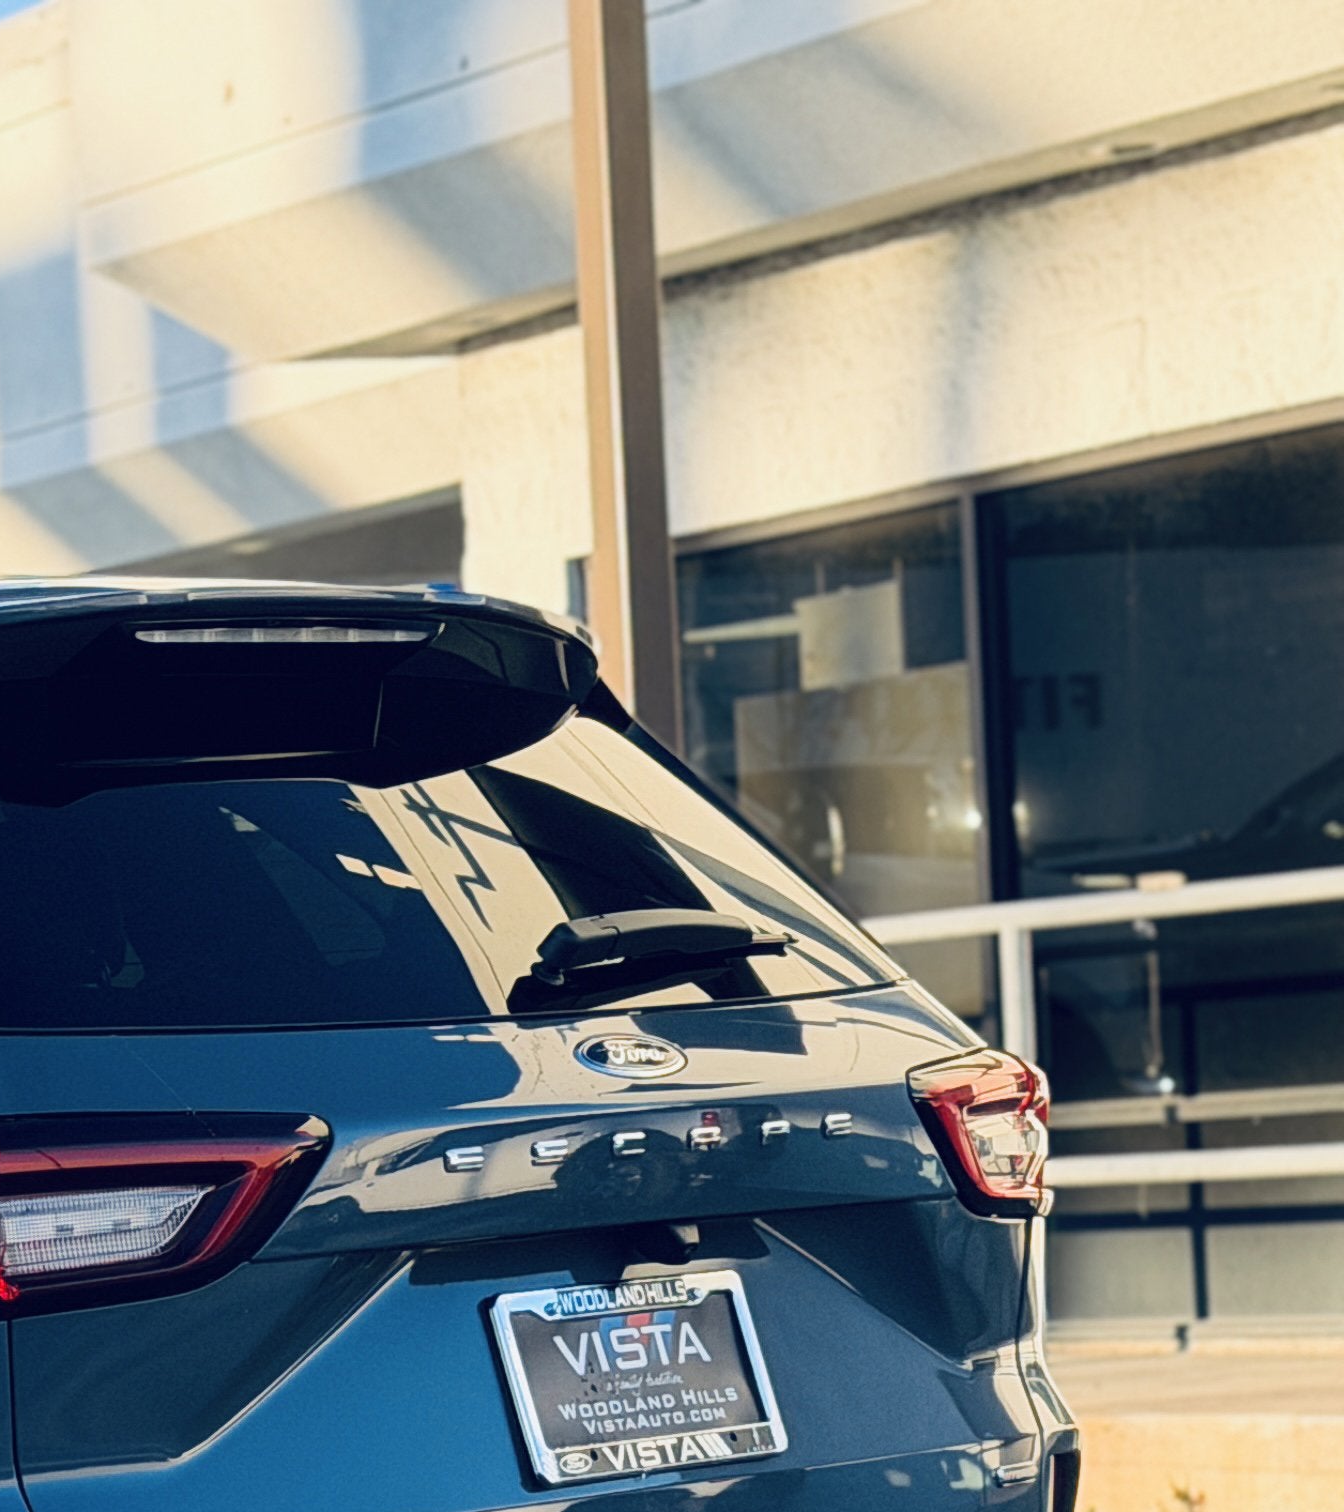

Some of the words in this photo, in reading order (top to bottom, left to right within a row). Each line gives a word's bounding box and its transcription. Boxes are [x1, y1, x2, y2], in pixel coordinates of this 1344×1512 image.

[601, 1039, 667, 1065] Ford
[443, 1111, 853, 1174] ESCAPE
[559, 1284, 647, 1315] WOODLAND
[647, 1279, 689, 1304] HILLS
[552, 1321, 712, 1377] VISTA
[601, 1434, 706, 1472] VISTA
